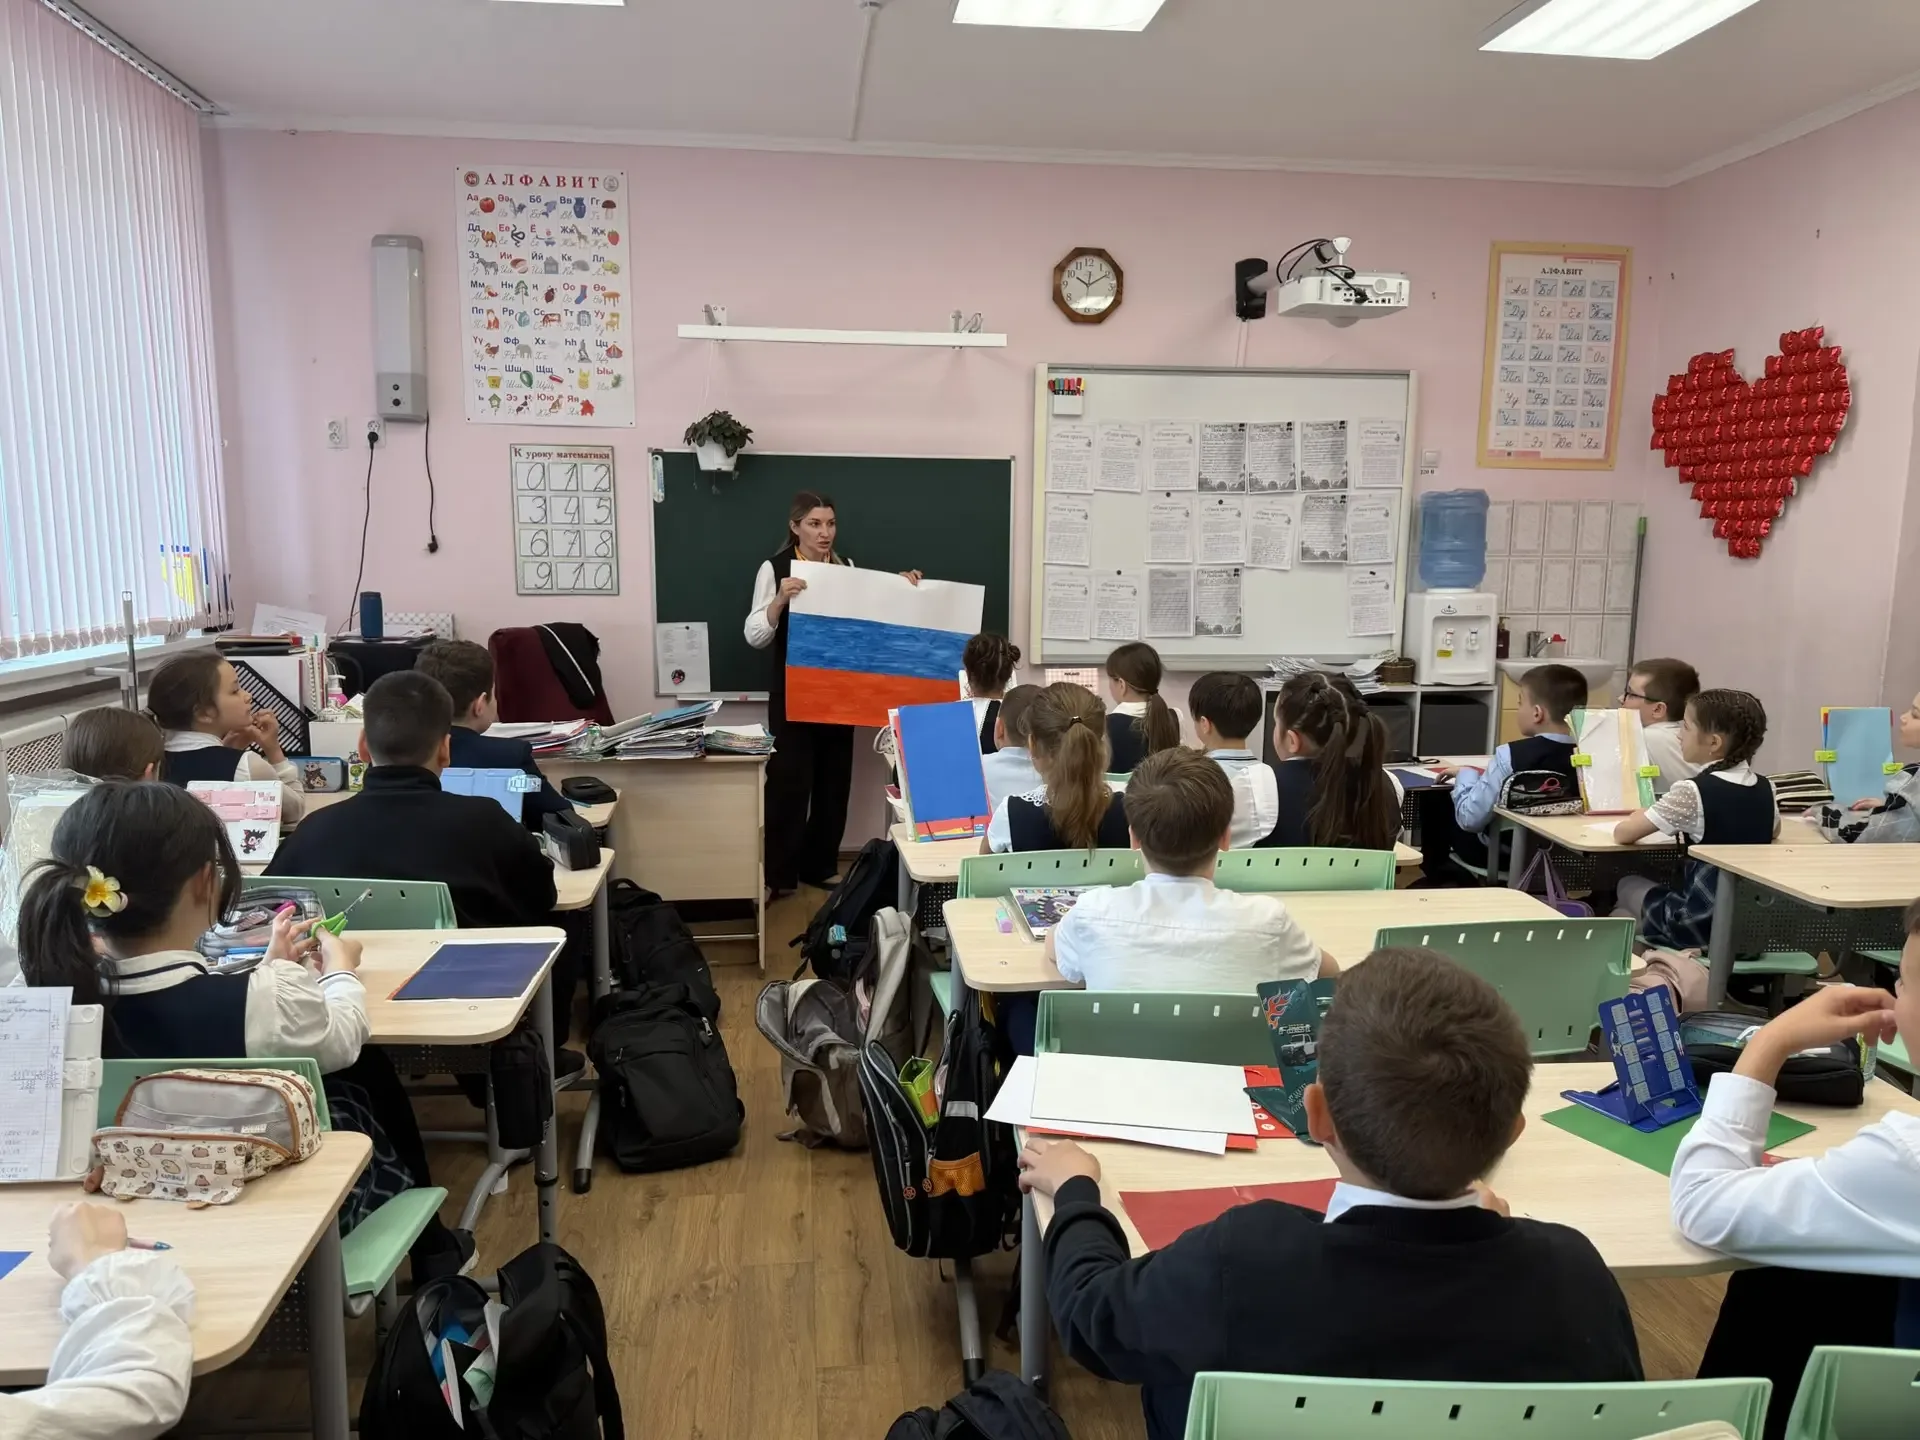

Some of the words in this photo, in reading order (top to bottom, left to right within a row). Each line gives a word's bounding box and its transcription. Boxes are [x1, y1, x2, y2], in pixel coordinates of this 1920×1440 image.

[485, 173, 599, 189] АЛФАВИТ
[467, 194, 479, 202] Аа
[530, 195, 542, 203] Бб
[560, 197, 572, 205] Вв
[590, 197, 601, 206] Гг
[468, 224, 481, 232] Дд
[499, 224, 510, 232] Ее
[561, 226, 575, 234] Жж
[469, 251, 479, 259] Зз
[500, 252, 512, 260] Ии
[532, 252, 544, 261] Йй
[562, 254, 572, 262] Кк
[1076, 262, 1082, 270] 11
[1085, 258, 1094, 267] 12
[1068, 270, 1076, 278] 10
[1541, 267, 1583, 276] АЛФАВИТ
[501, 281, 513, 289] Нн
[563, 283, 575, 291] Оо
[1108, 283, 1114, 291] 3
[1066, 293, 1072, 301] 8
[472, 307, 484, 315] Пп
[503, 308, 514, 316] Рр
[534, 308, 545, 316] Сс
[594, 310, 605, 319] Уу
[504, 337, 520, 345] Фф
[596, 340, 608, 348] Цц
[505, 365, 522, 373] Шш
[536, 366, 553, 374] Щщ
[537, 394, 555, 402] Юю
[568, 395, 579, 403] Яя
[514, 448, 522, 457] К
[526, 451, 553, 460] уроку
[557, 451, 610, 460] математики
[527, 463, 545, 490] 0
[564, 463, 577, 491] 1
[593, 464, 610, 492] 2
[530, 496, 546, 524] 3
[564, 497, 579, 524] 4
[594, 497, 611, 525] 5
[531, 529, 548, 557] 6
[564, 530, 580, 557] 7
[595, 530, 612, 557] 8
[535, 562, 552, 589] 9
